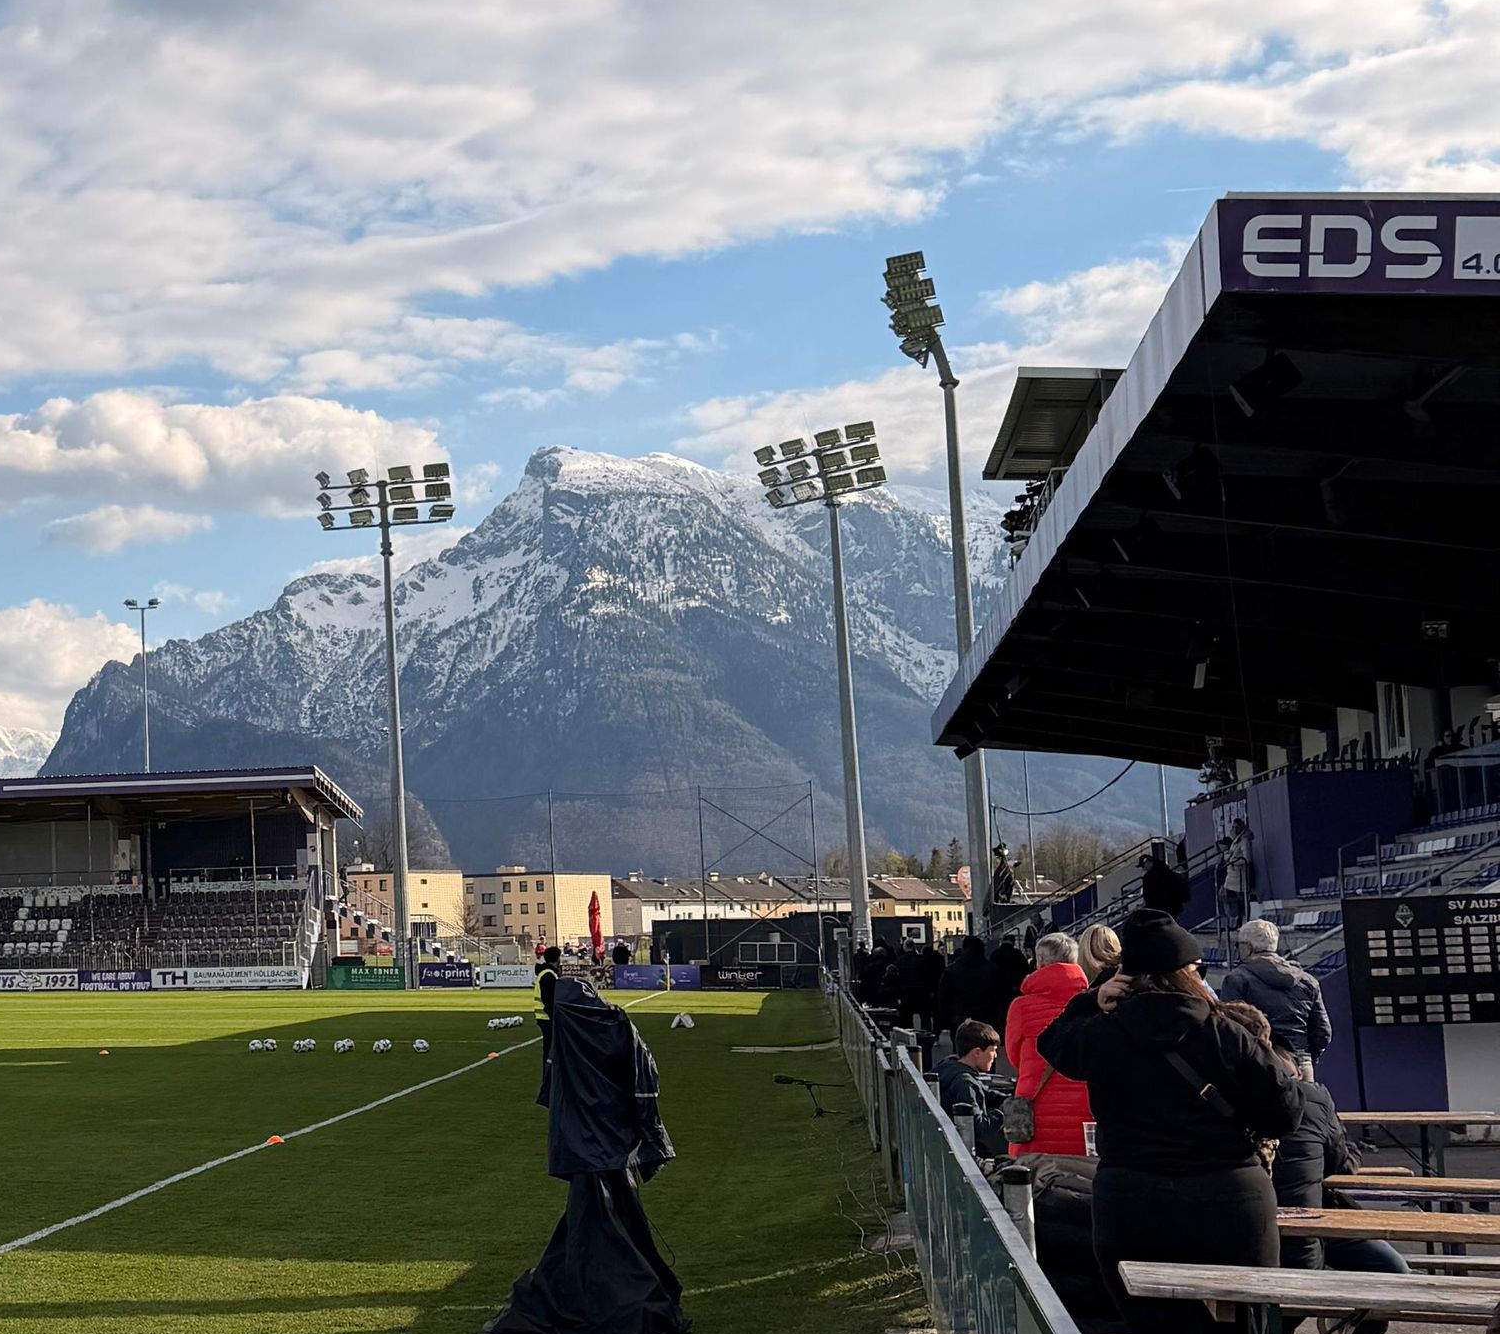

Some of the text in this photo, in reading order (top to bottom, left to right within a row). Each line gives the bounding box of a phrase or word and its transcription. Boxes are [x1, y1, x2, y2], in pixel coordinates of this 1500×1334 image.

[1243, 213, 1442, 279] EDS
[1448, 899, 1467, 910] SV
[1453, 914, 1500, 925] SALZB
[91, 971, 136, 981] WE CARE ABOUT
[351, 967, 369, 975] MAX
[497, 968, 530, 977] PROJECT
[45, 974, 76, 988] 1992
[157, 970, 187, 985] TH
[193, 970, 252, 979] BAUMANAGEMENT
[253, 969, 298, 978] HÖLLBACHER
[119, 981, 130, 990] DO
